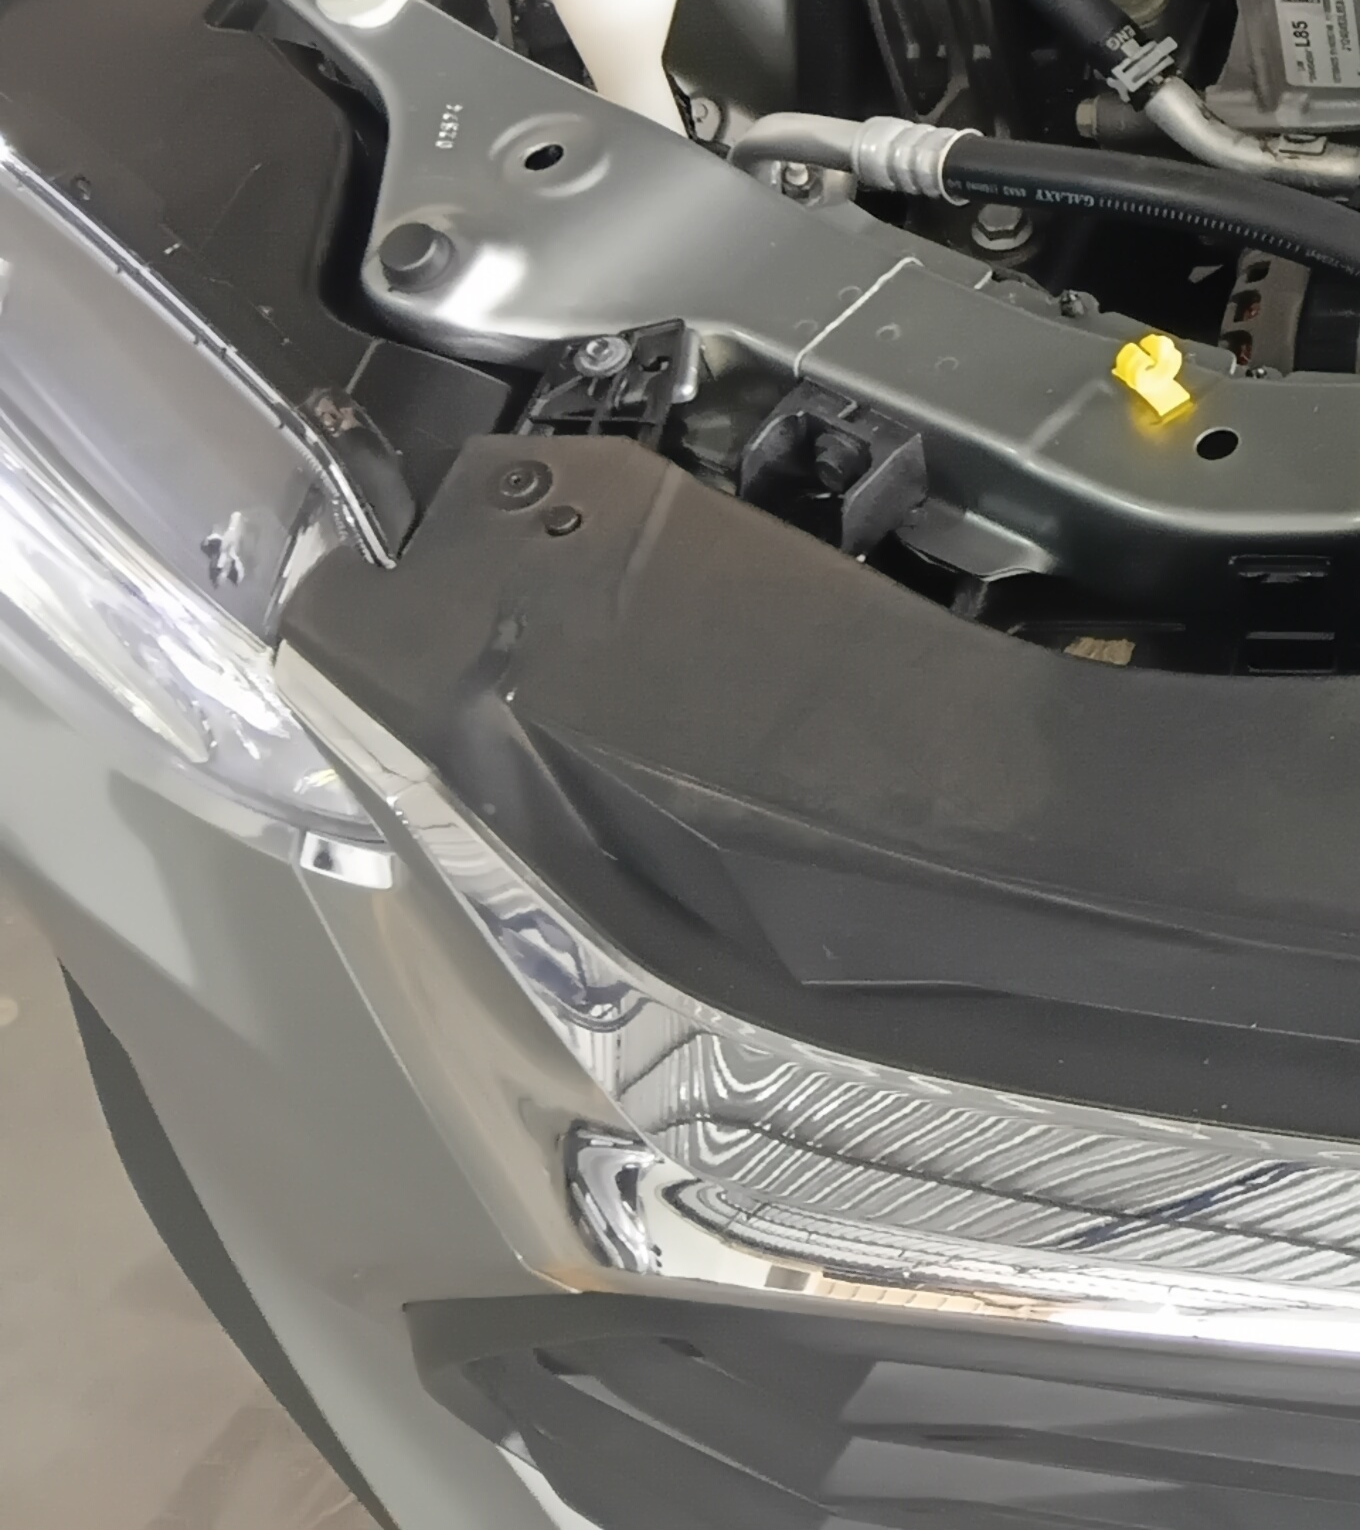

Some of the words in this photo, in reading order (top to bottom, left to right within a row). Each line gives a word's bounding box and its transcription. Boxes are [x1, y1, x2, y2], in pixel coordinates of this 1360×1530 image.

[1105, 25, 1137, 51] ENG
[1291, 20, 1311, 48] L85
[1035, 188, 1095, 208] GALAXY
